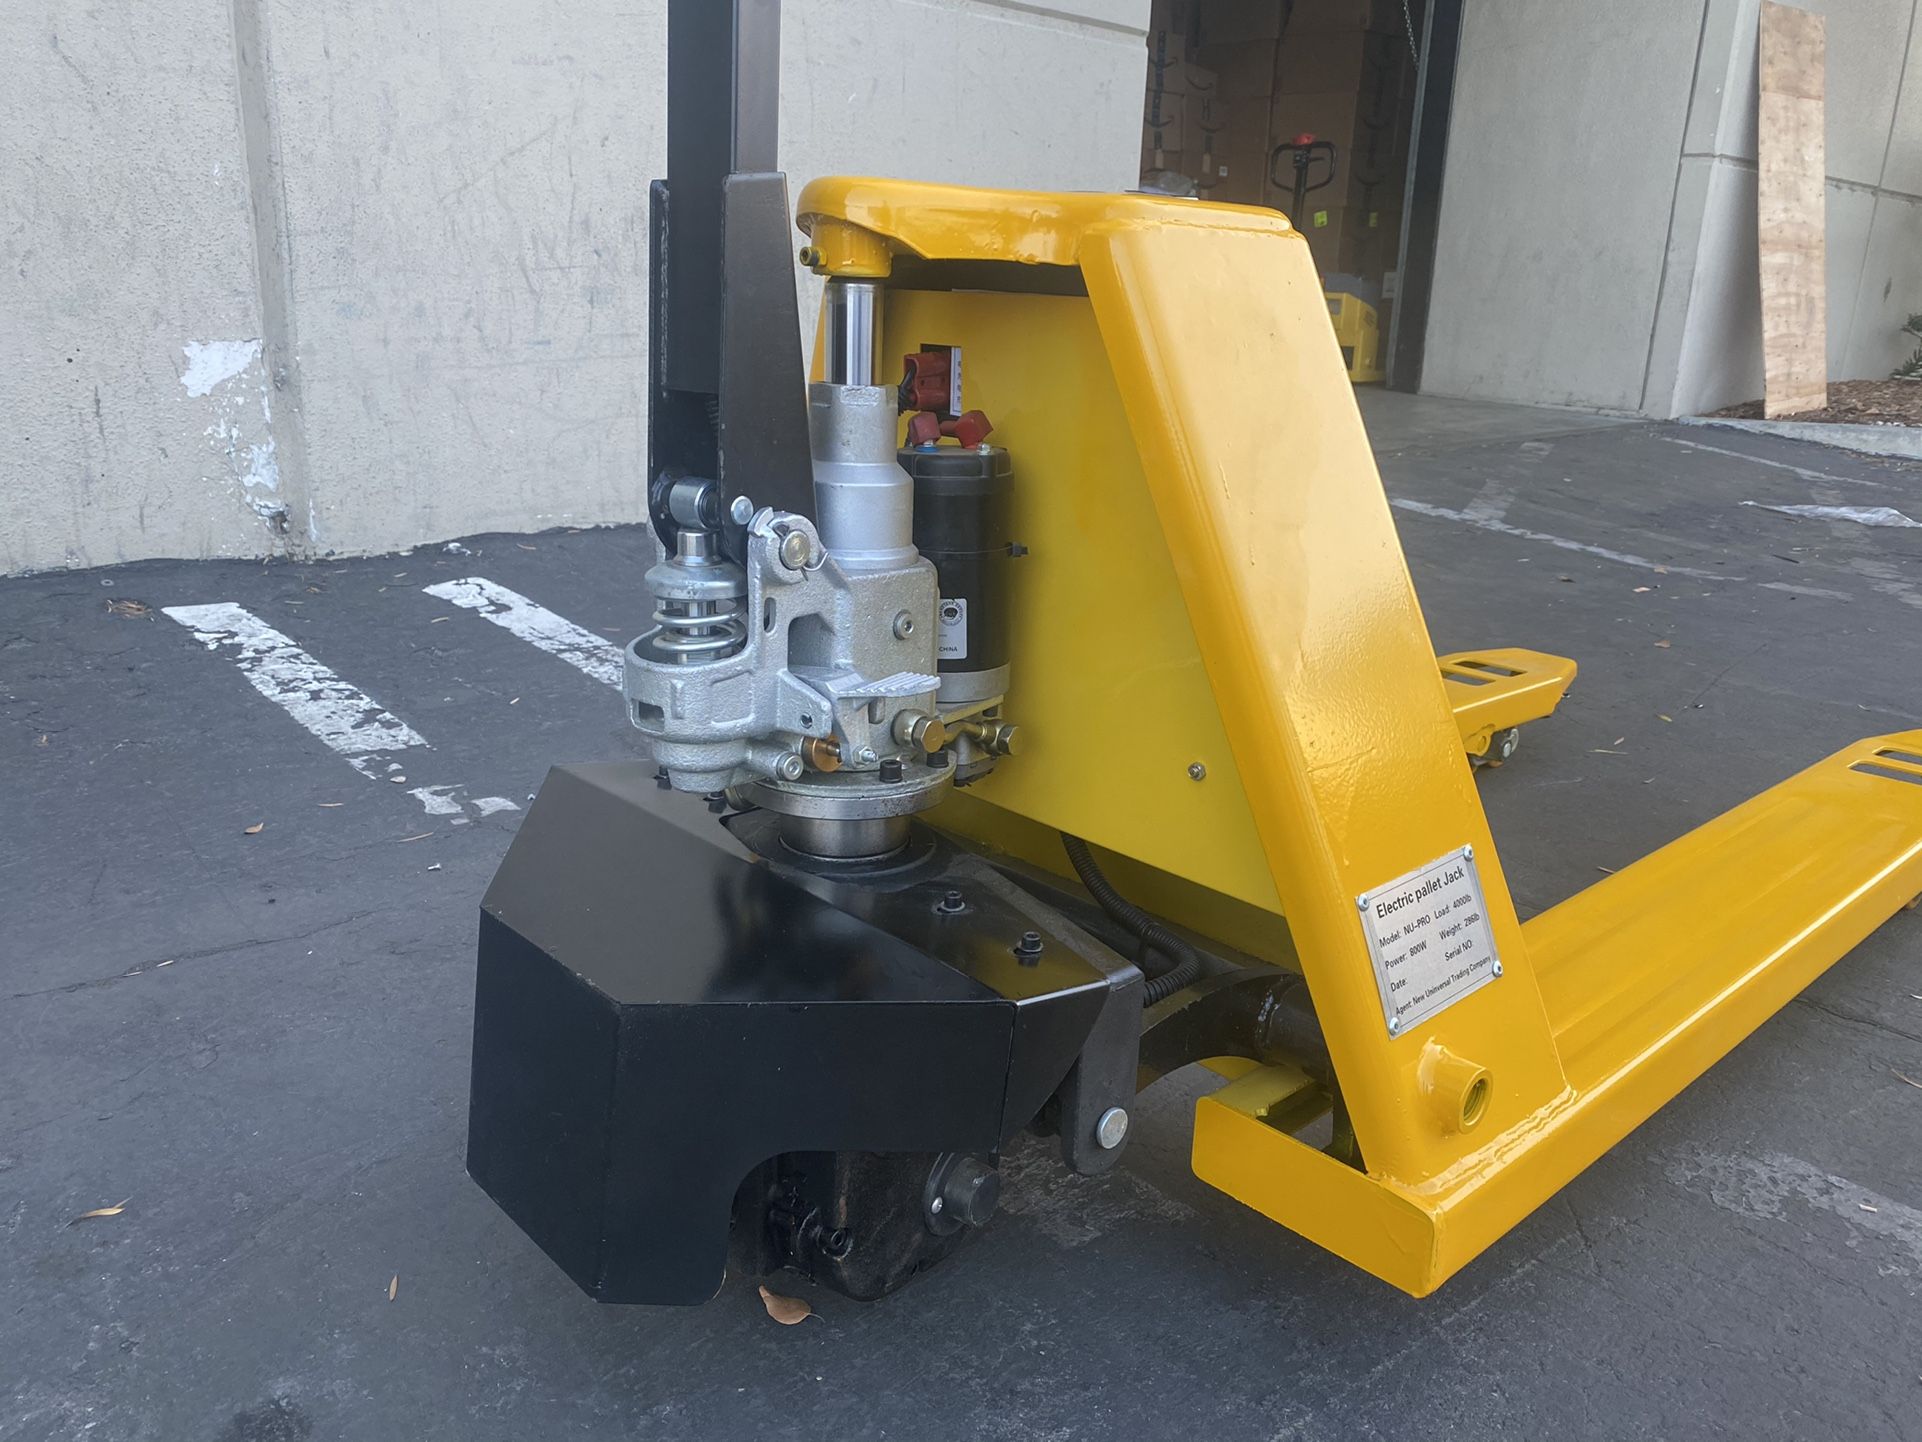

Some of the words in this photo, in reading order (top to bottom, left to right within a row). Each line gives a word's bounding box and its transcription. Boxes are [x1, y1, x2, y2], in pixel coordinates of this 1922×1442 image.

[1376, 892, 1413, 918] Electric
[1415, 878, 1442, 902] pallet
[1444, 866, 1464, 886] Jack
[1434, 904, 1451, 920] Load:
[1379, 930, 1401, 948] Model:
[1403, 914, 1431, 936] NU-PRO
[1439, 923, 1462, 940] Weight:
[1385, 953, 1407, 970] Power:
[1409, 940, 1427, 957] 800W
[1444, 944, 1462, 961] Serial
[1390, 978, 1408, 992] Date:
[1395, 1001, 1412, 1016] Agent:
[1412, 993, 1425, 1006] New
[1451, 967, 1470, 982] Trading
[1469, 956, 1491, 972] Company
